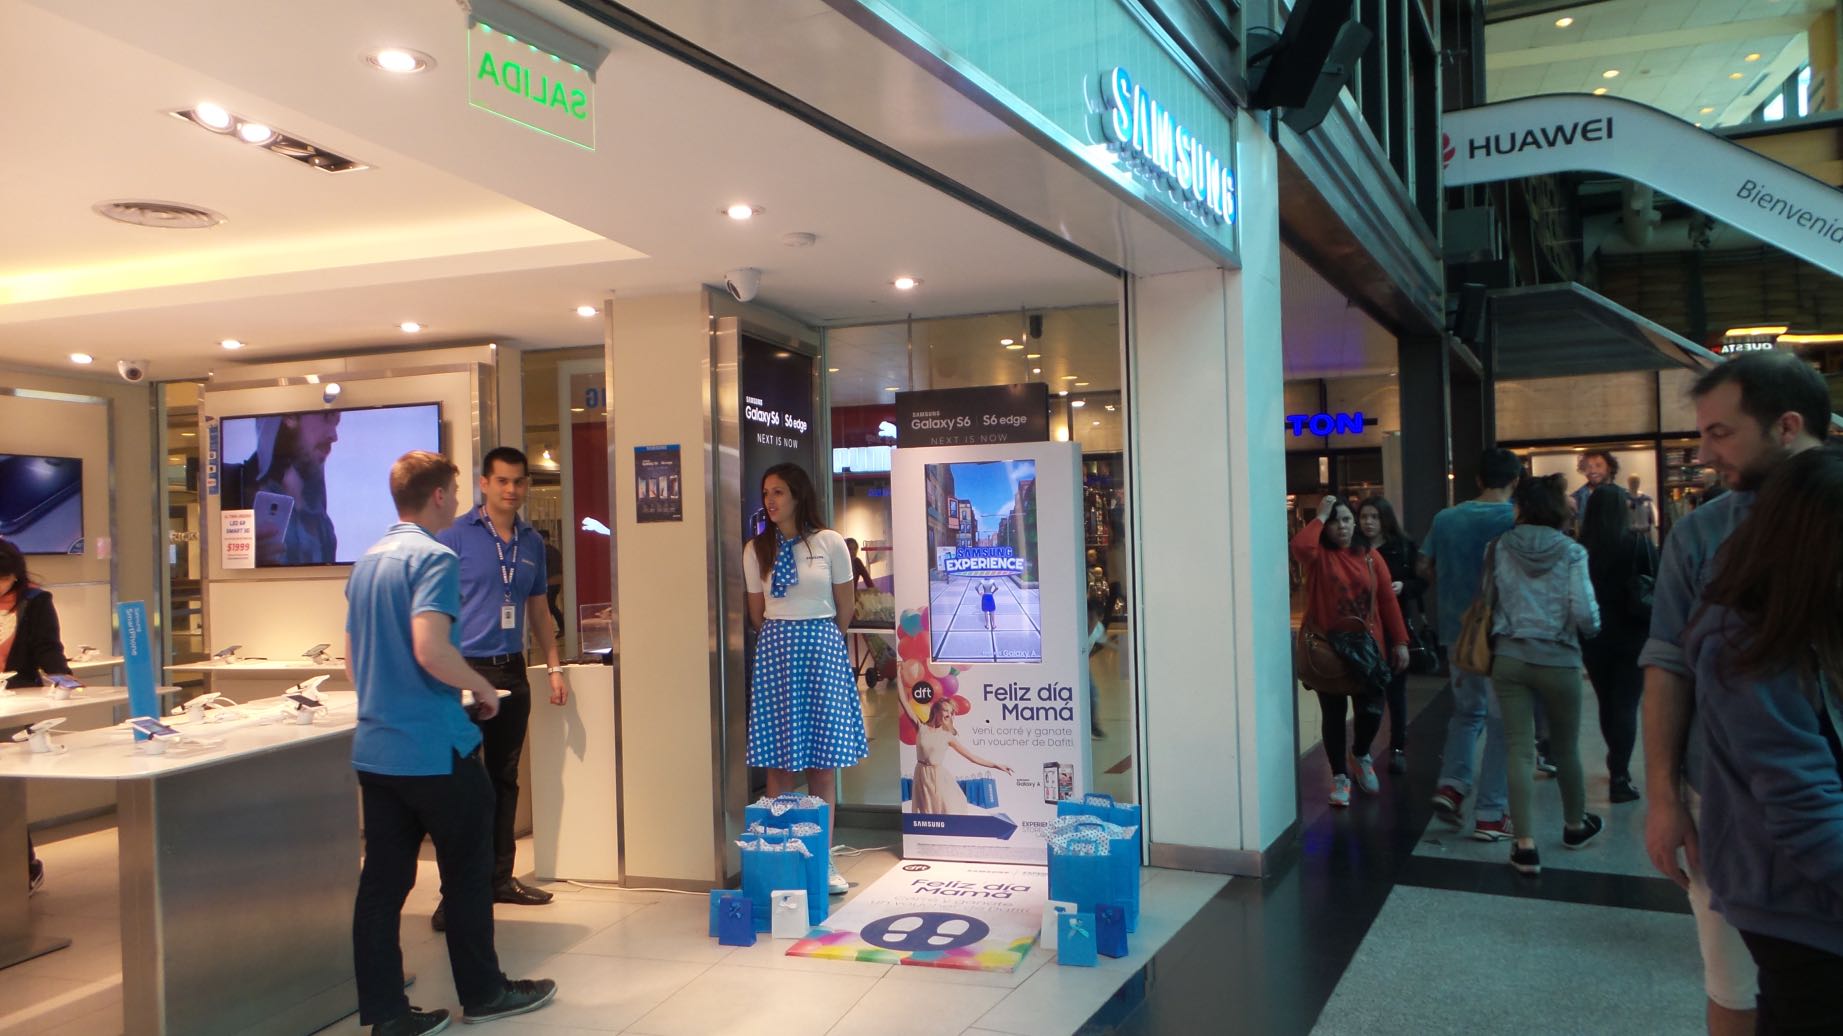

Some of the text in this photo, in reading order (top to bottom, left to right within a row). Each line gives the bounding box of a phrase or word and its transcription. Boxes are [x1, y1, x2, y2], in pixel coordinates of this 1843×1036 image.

[1468, 117, 1614, 159] HUAWEI
[1111, 66, 1236, 225] SAMSUNG
[745, 405, 808, 433] Galaxy S6 S6 edge
[912, 410, 940, 418] SAMSUNG
[911, 414, 1027, 431] Galaxy S6 S6 edge
[757, 433, 798, 449] NEXT IS NOW
[930, 433, 1008, 445] NEXT IS NOW
[227, 543, 250, 552] $1999
[957, 547, 1013, 558] SAMSUNG
[946, 558, 1024, 571] EXPERIENCE
[1002, 650, 1028, 659] Galaxy
[914, 687, 932, 699] dft
[983, 681, 1073, 701] Feliz día
[1002, 701, 1074, 721] Mamá
[1026, 728, 1031, 738] y
[1034, 728, 1073, 738] ganate
[972, 737, 1075, 748] un voucher de Dafiti
[913, 820, 945, 828] SAMSUNG
[911, 878, 975, 889] Feliz
